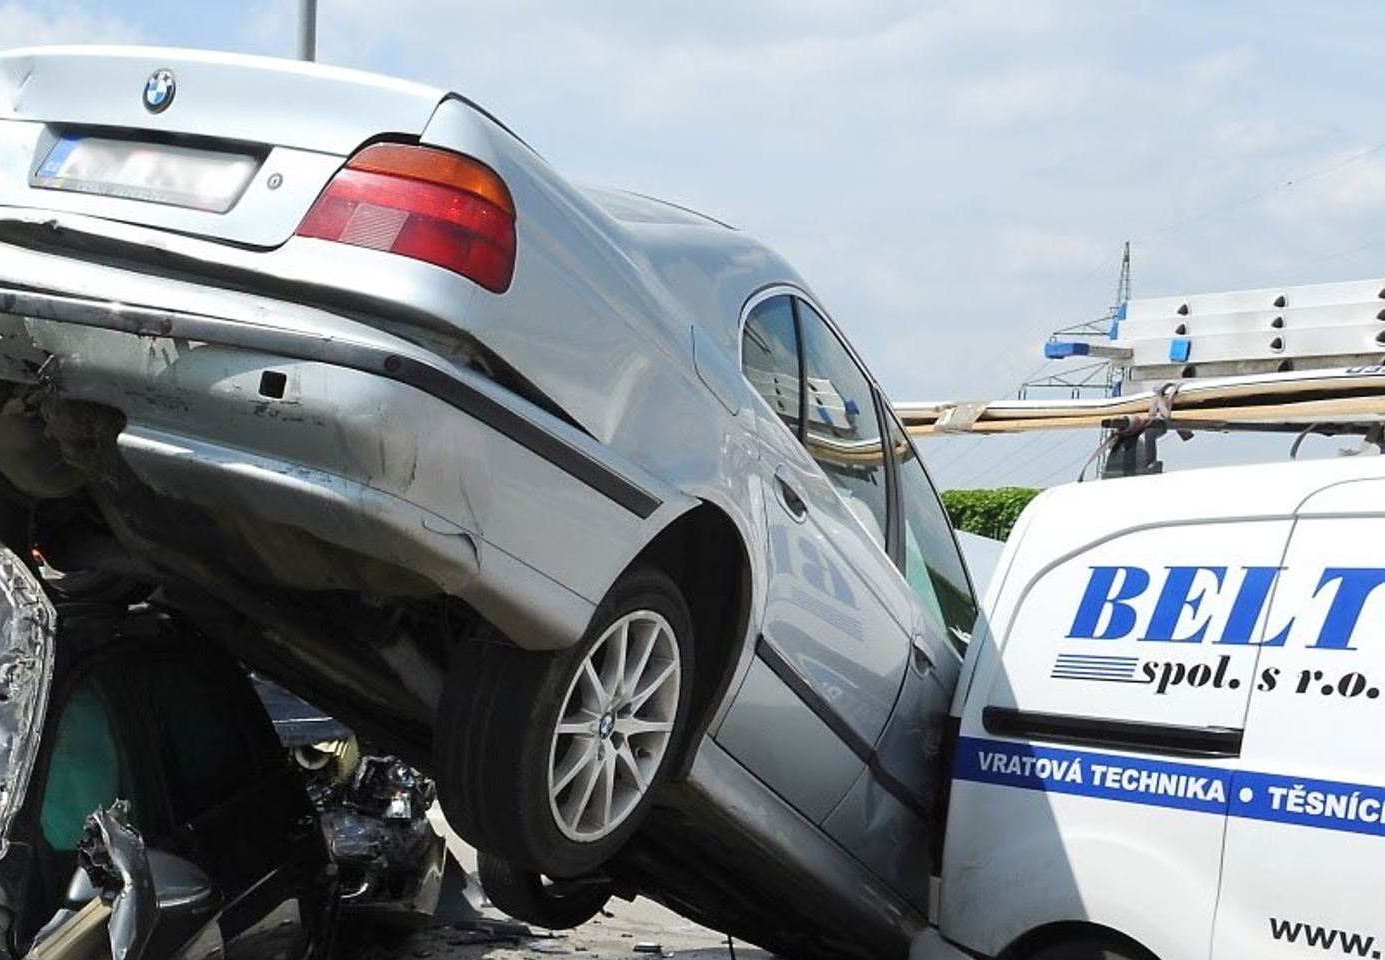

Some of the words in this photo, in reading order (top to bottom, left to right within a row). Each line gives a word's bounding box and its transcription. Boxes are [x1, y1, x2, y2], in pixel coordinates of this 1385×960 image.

[1065, 566, 1385, 650] BELT
[1142, 655, 1241, 695] spol.
[1257, 667, 1280, 692] s
[1295, 669, 1380, 699] r.o.
[978, 751, 1083, 785] VRATOVÁ
[1091, 763, 1226, 803] TECHNIKA
[1269, 917, 1381, 960] www.
